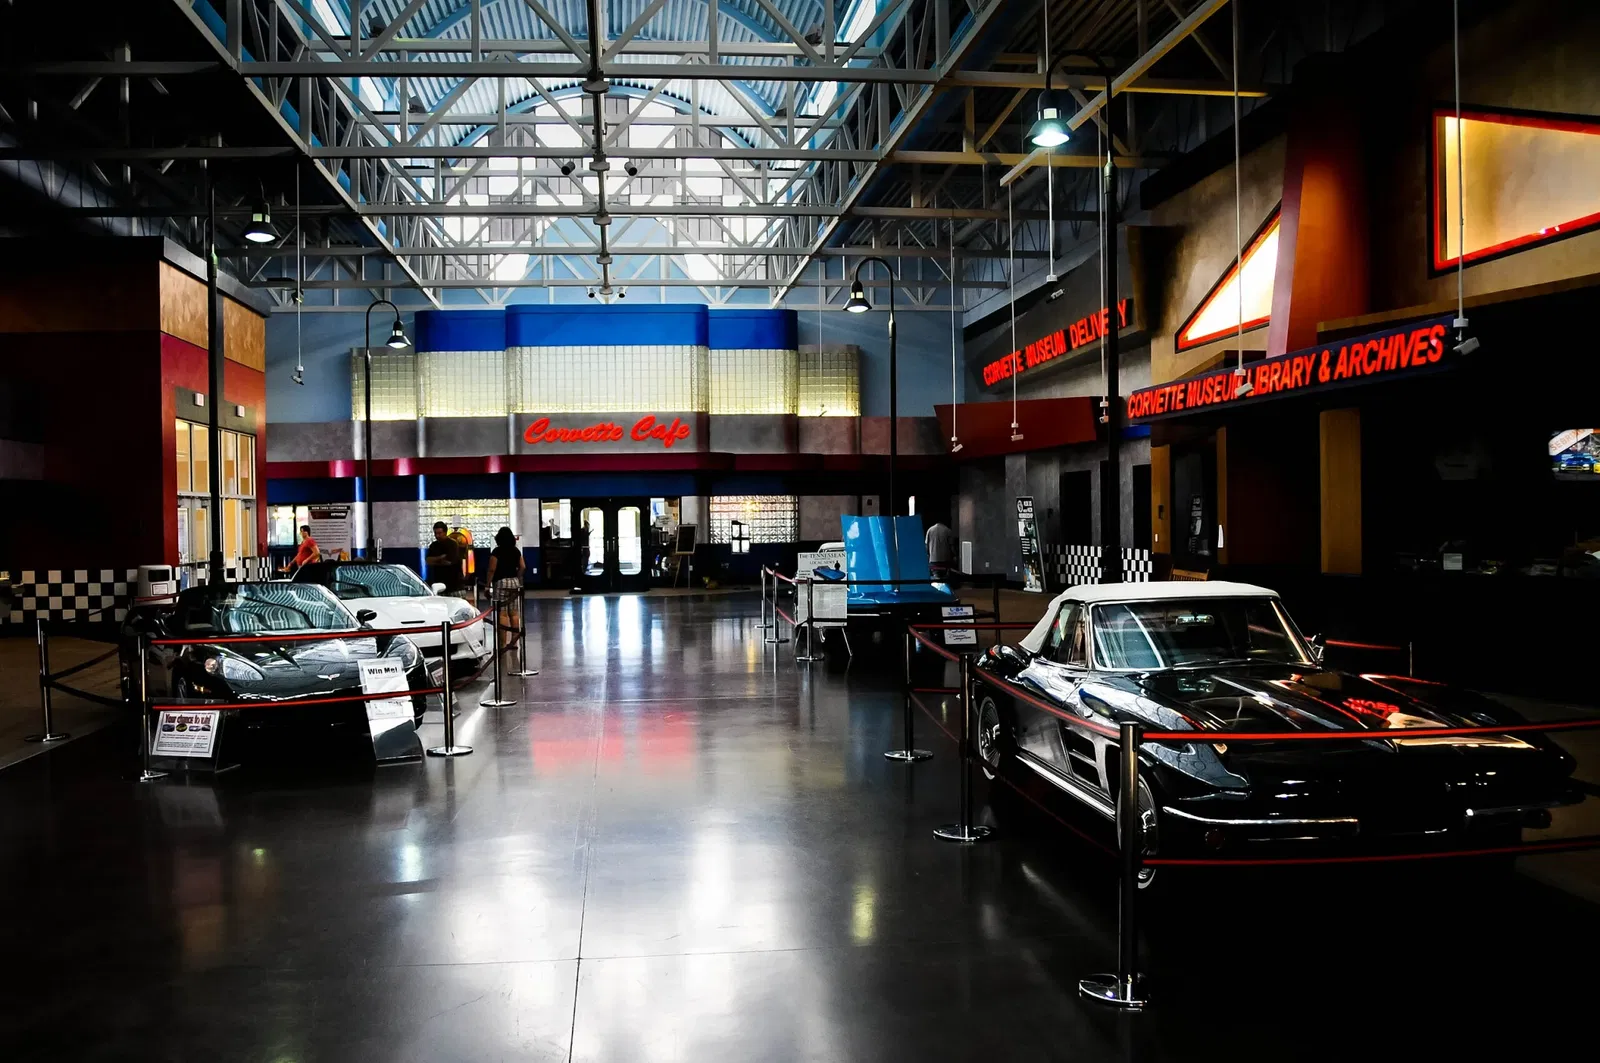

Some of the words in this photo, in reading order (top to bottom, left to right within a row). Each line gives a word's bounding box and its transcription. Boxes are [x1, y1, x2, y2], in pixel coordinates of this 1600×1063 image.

[983, 350, 1024, 387] CORVETTE
[1025, 329, 1067, 368] MUSEUM
[1069, 298, 1127, 349] DELIVEY
[1127, 383, 1185, 419] CORVETTE
[1318, 349, 1331, 383] &
[1333, 324, 1446, 380] ARCHIVES
[523, 417, 624, 444] Corvette
[630, 414, 690, 448] Cafe
[165, 714, 176, 723] Your
[177, 715, 193, 724] chance
[194, 715, 200, 724] to
[201, 716, 211, 725] win!
